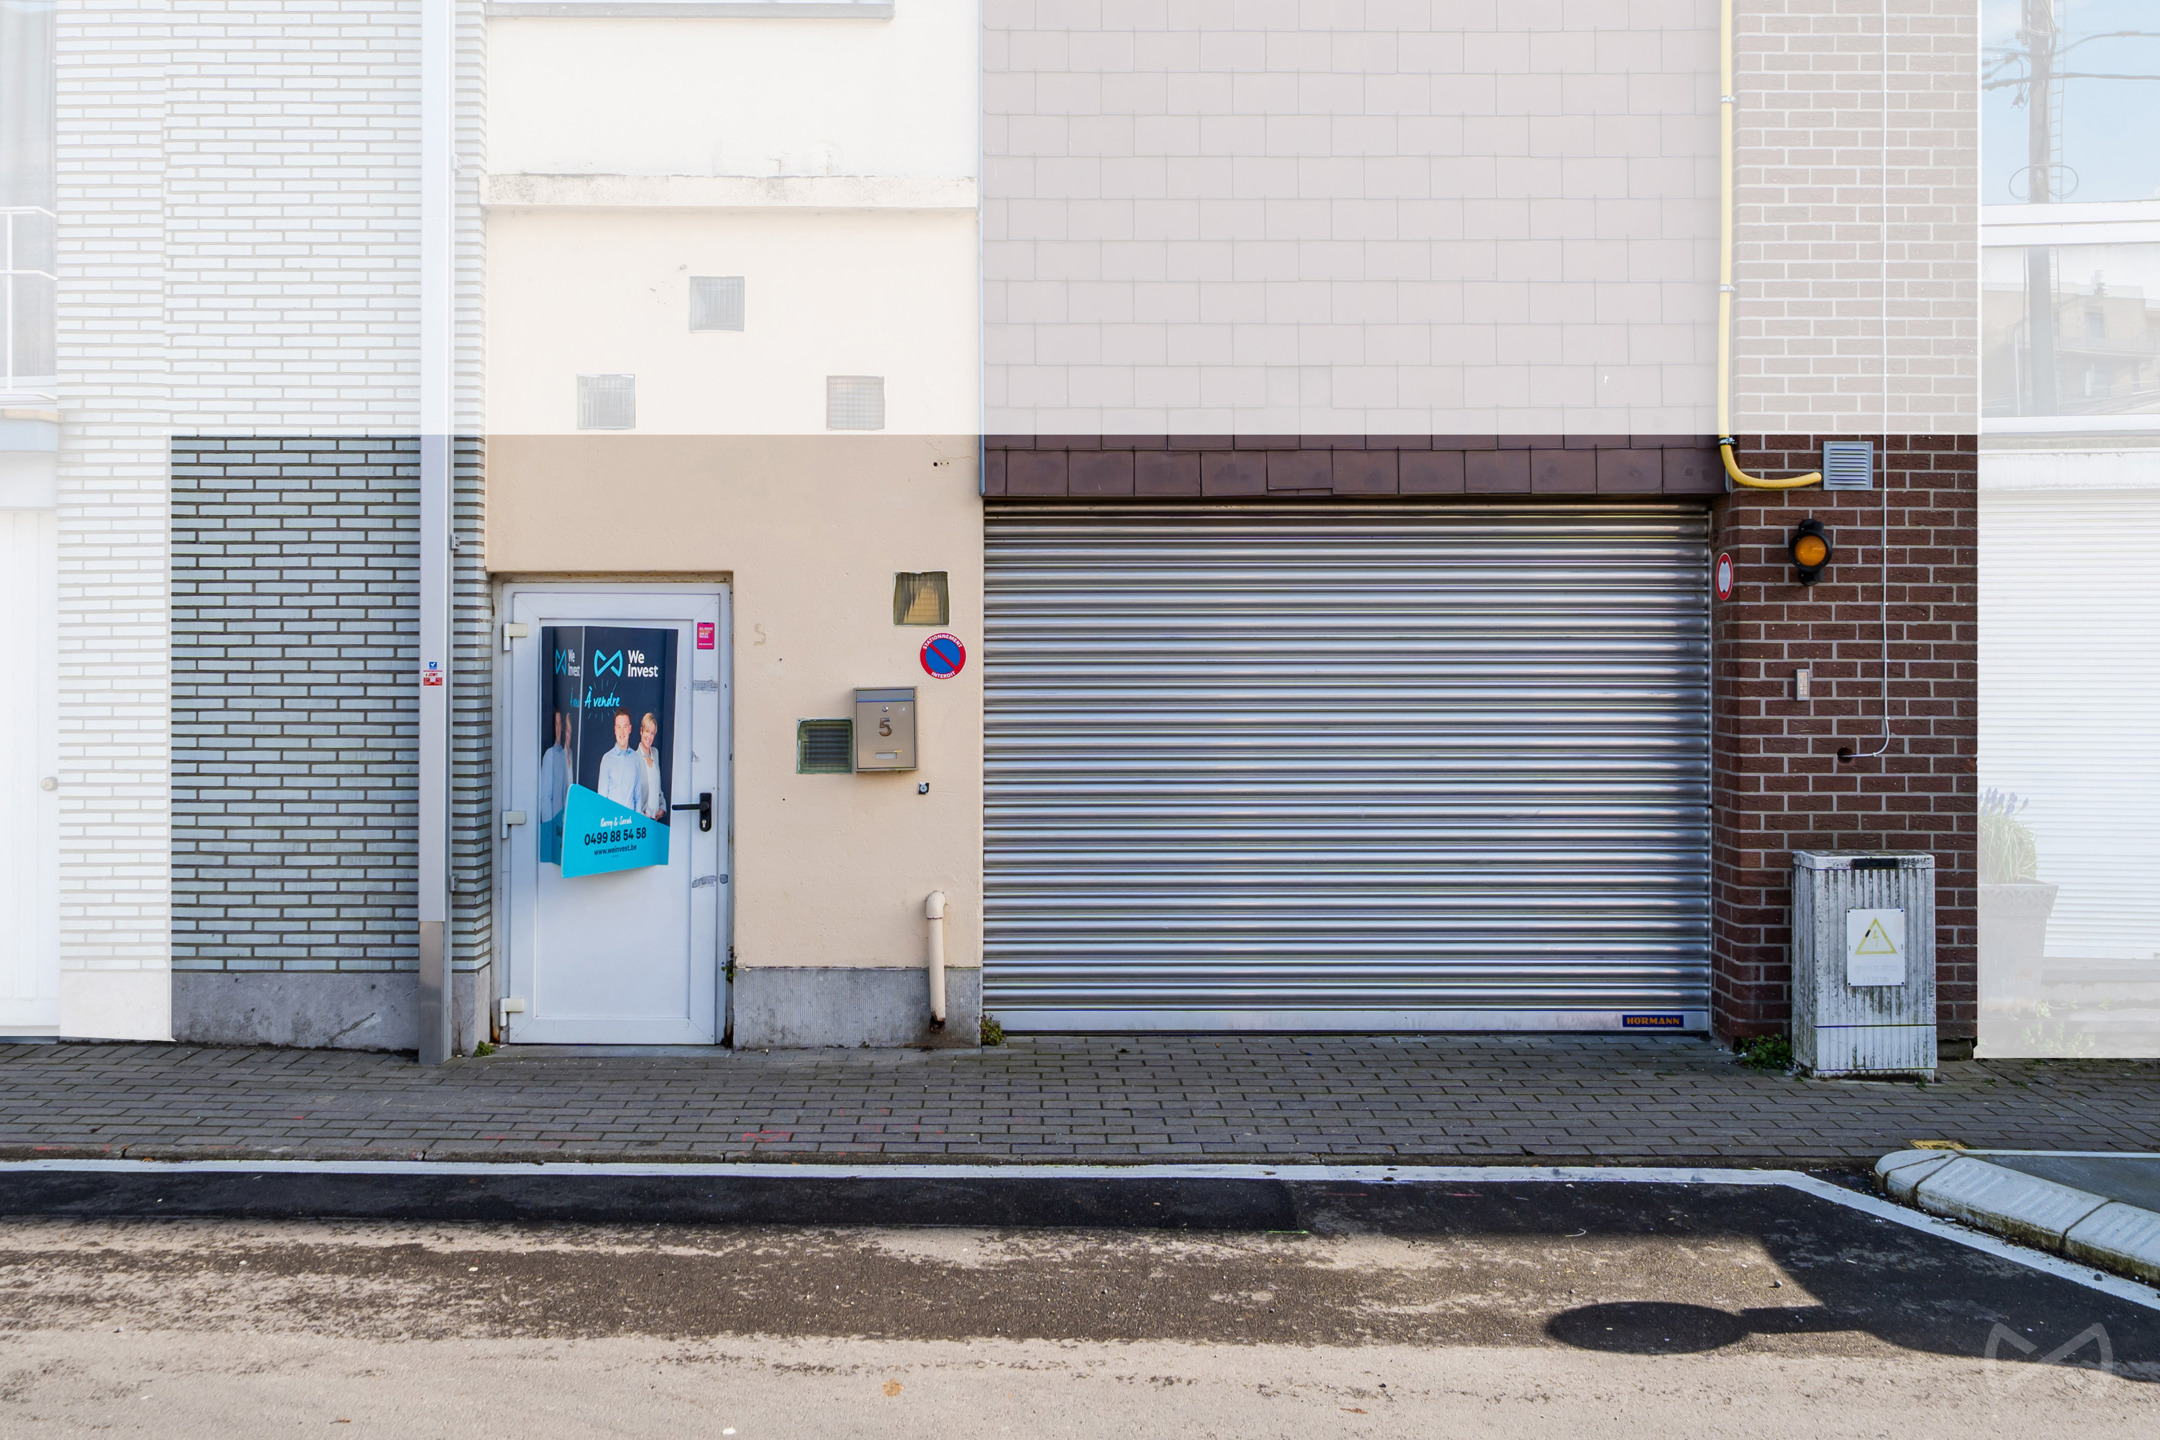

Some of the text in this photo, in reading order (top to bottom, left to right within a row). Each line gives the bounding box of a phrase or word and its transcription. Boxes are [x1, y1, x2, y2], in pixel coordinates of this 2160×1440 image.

[922, 634, 963, 650] STATIONNEMENT
[627, 649, 645, 664] We
[627, 663, 659, 677] Invest
[931, 670, 956, 679] INTERDIT
[584, 685, 593, 709] À
[593, 691, 621, 707] vendre
[879, 717, 893, 737] 5
[584, 827, 647, 846] 0499 88 54 58
[593, 844, 638, 856] www.weinvest.be
